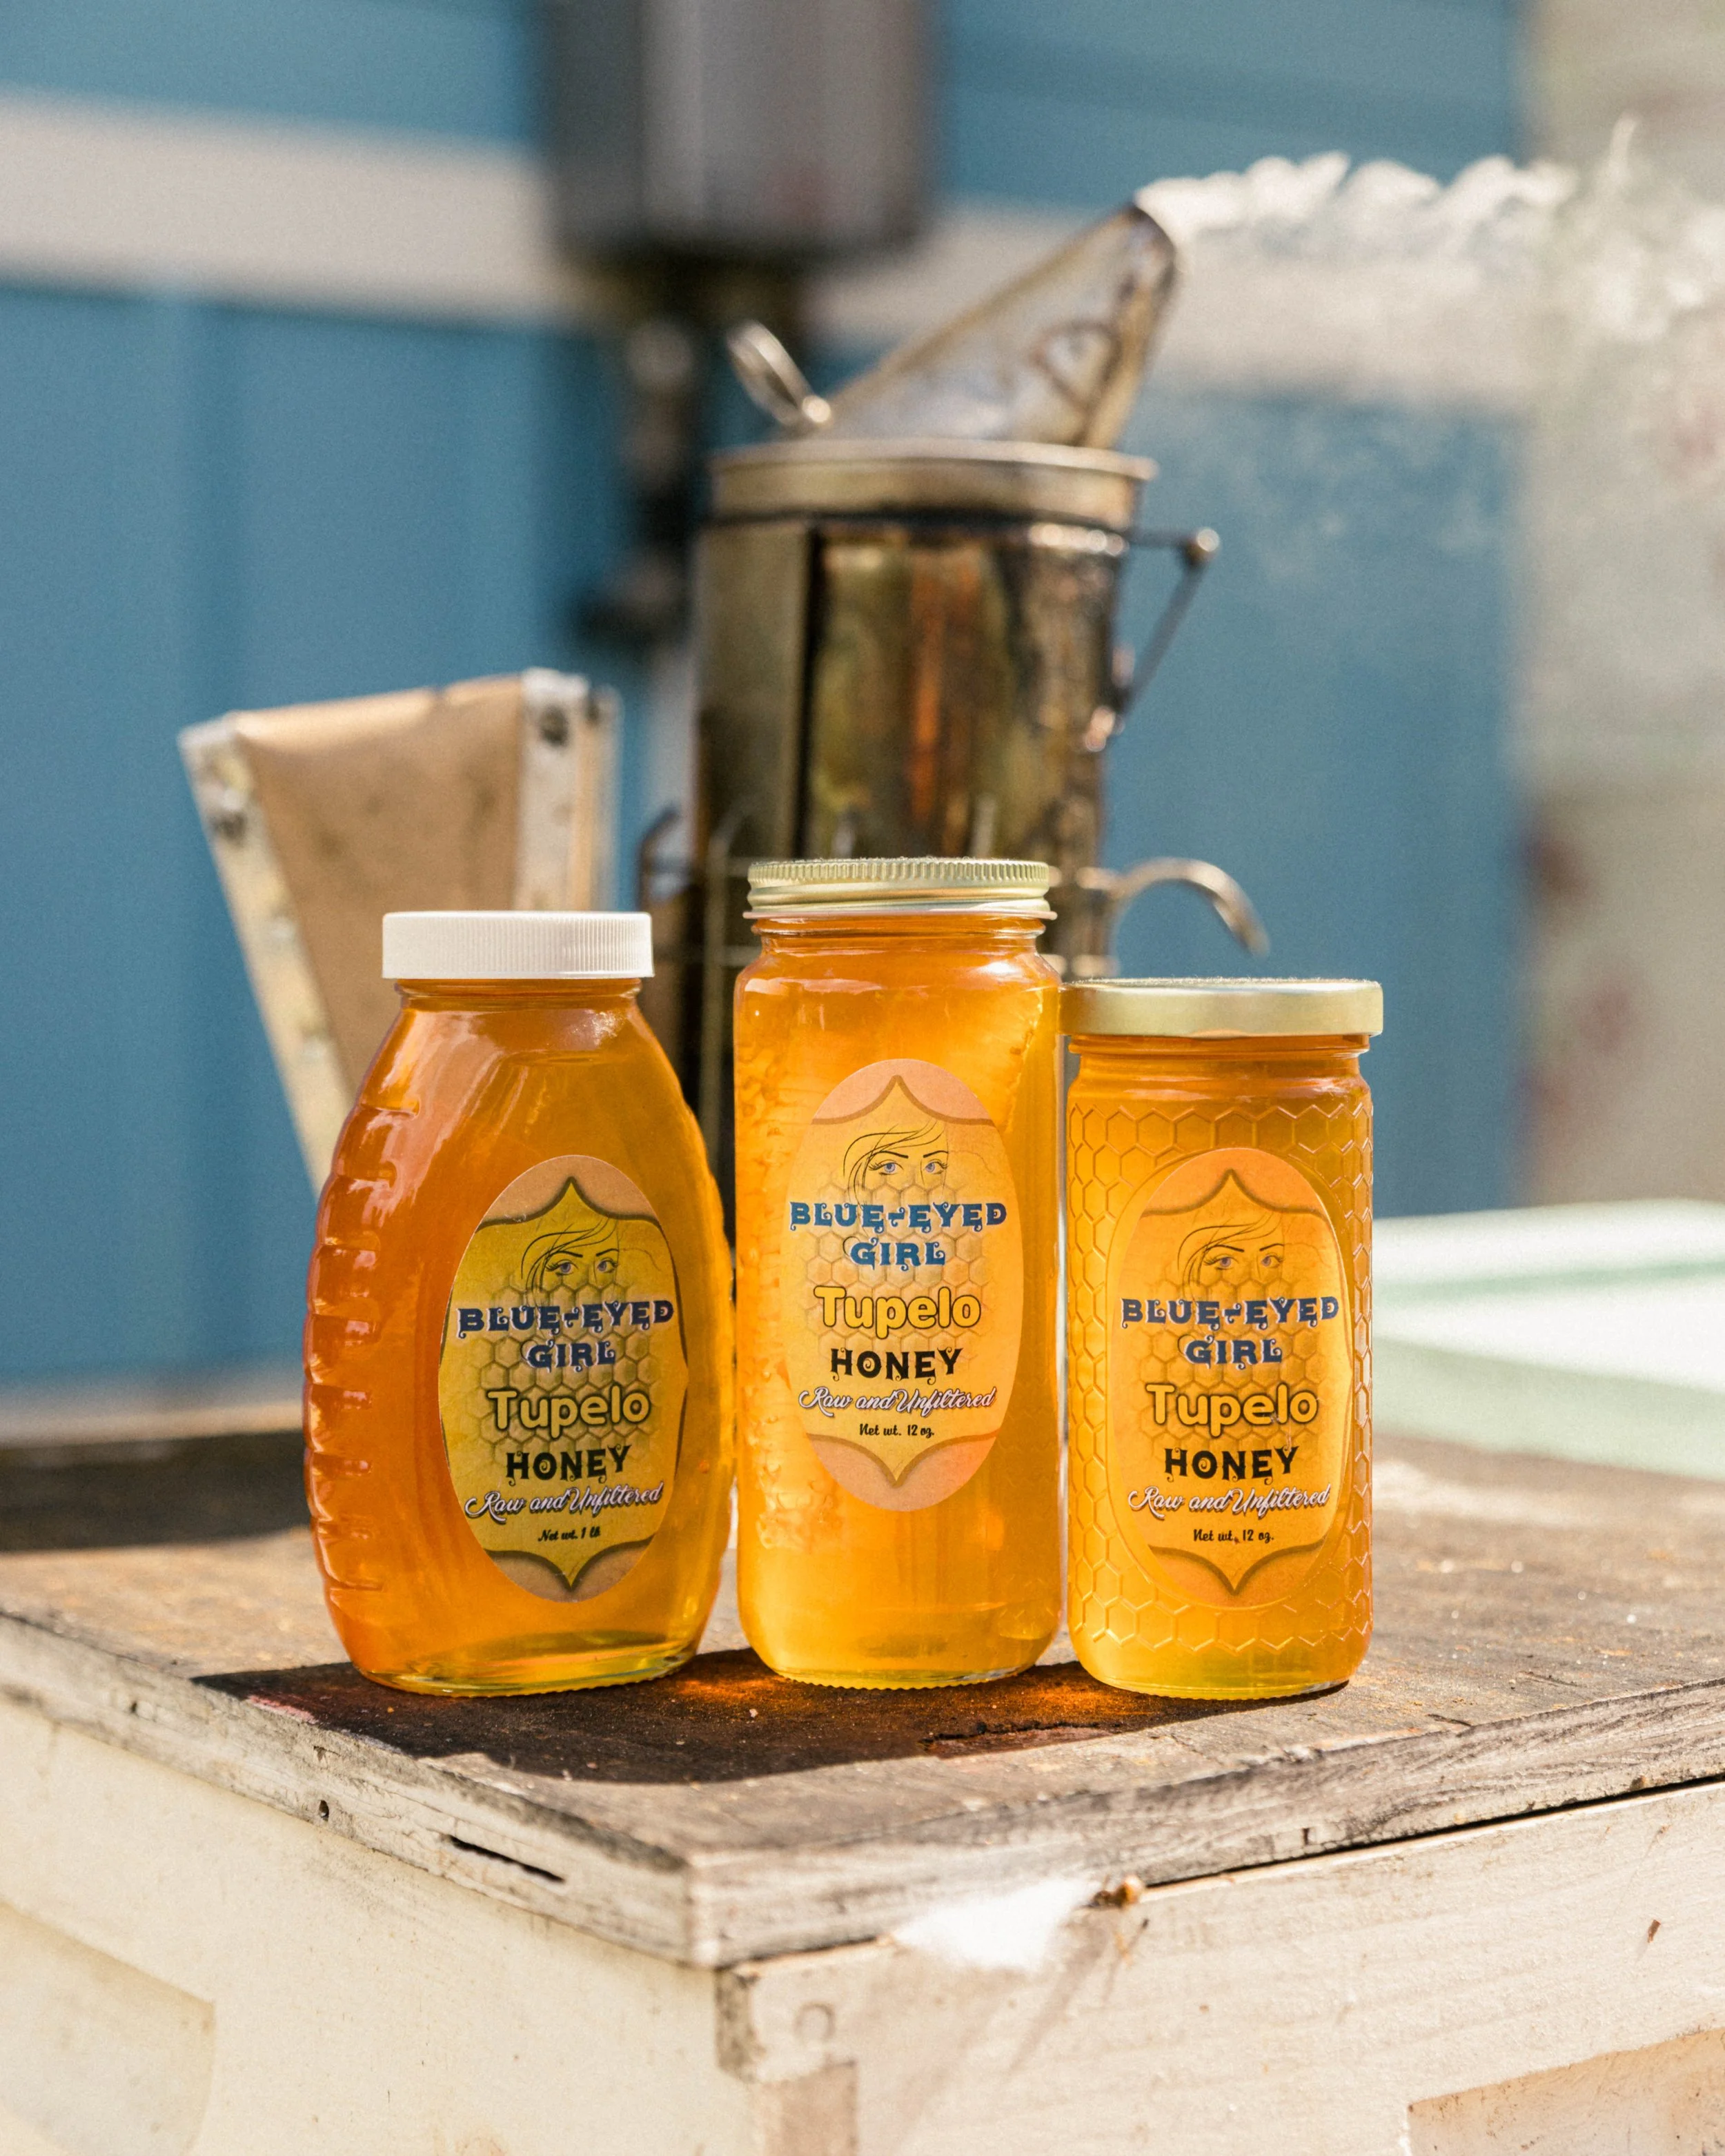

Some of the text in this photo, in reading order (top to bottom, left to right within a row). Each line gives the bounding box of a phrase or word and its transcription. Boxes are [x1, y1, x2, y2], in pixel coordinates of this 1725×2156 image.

[789, 1202, 1007, 1234] BLUE-EYED
[849, 1237, 946, 1271] GIRL
[456, 1299, 673, 1338] BLUE-EYED
[814, 1285, 981, 1339] Tupelo
[1121, 1296, 1339, 1329] BLUE-EYED
[526, 1341, 615, 1372] GIRL
[830, 1347, 963, 1384] HONEY
[1183, 1336, 1283, 1369] GIRL
[487, 1384, 651, 1438] Tupelo
[798, 1386, 997, 1418] Raw and Unfiltered
[1145, 1382, 1320, 1437] Tupelo
[859, 1423, 880, 1436] Net
[907, 1424, 918, 1436] 12
[920, 1426, 935, 1438] oz.
[506, 1445, 631, 1485] HONEY
[1163, 1445, 1300, 1485] HONEY
[464, 1481, 664, 1524] Raw and Unfiltered
[1127, 1483, 1331, 1520] Raw and Unfiltered
[538, 1530, 558, 1541] Net
[580, 1527, 586, 1539] 1
[1194, 1529, 1214, 1541] Net
[1243, 1530, 1253, 1541] 12
[1259, 1532, 1274, 1543] oz.
